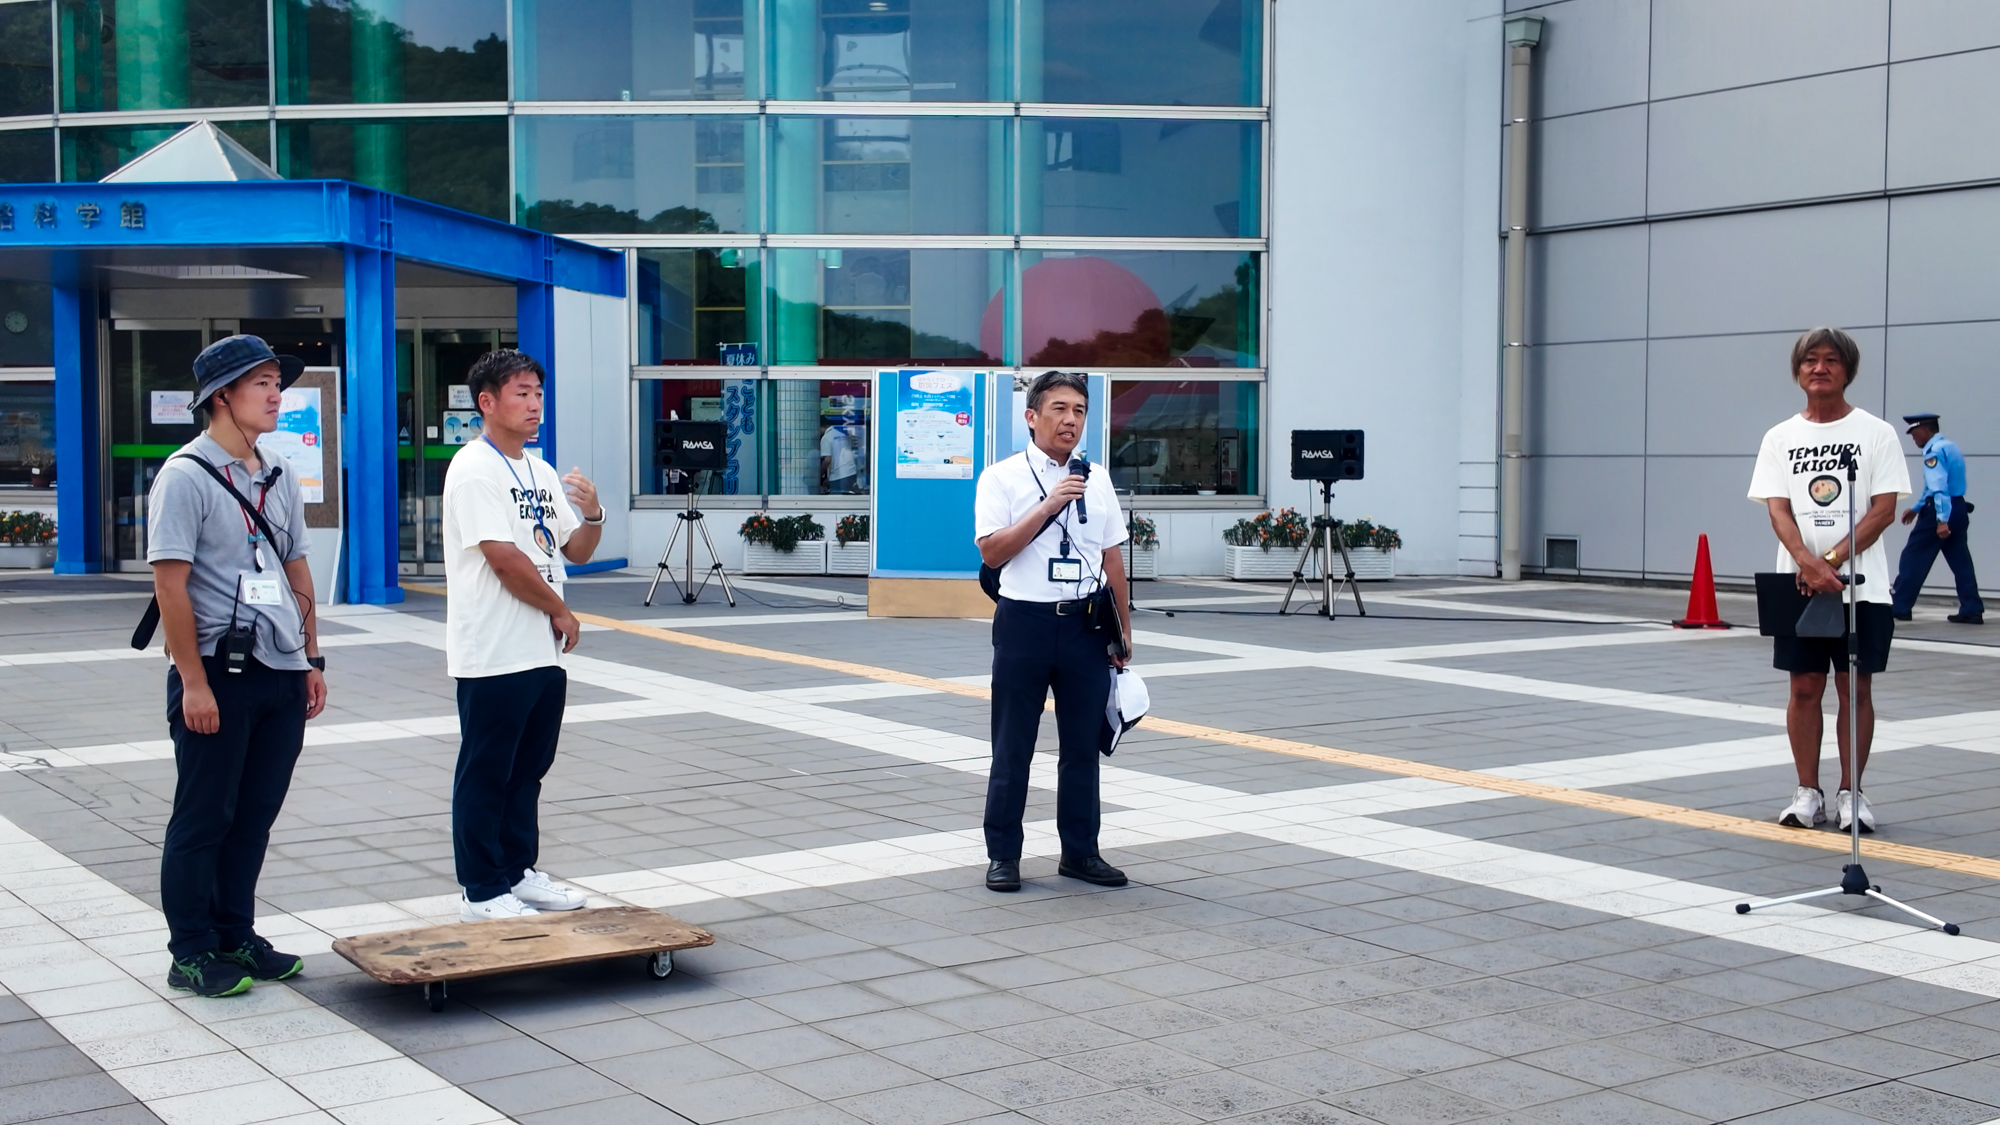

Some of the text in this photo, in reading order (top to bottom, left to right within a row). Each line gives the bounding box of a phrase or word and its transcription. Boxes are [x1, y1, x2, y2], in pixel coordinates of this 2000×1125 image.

[682, 440, 714, 449] RAMSA
[1301, 450, 1334, 459] RAMSA
[1788, 443, 1862, 461] TEMPURA
[519, 503, 558, 520] EKIOBA
